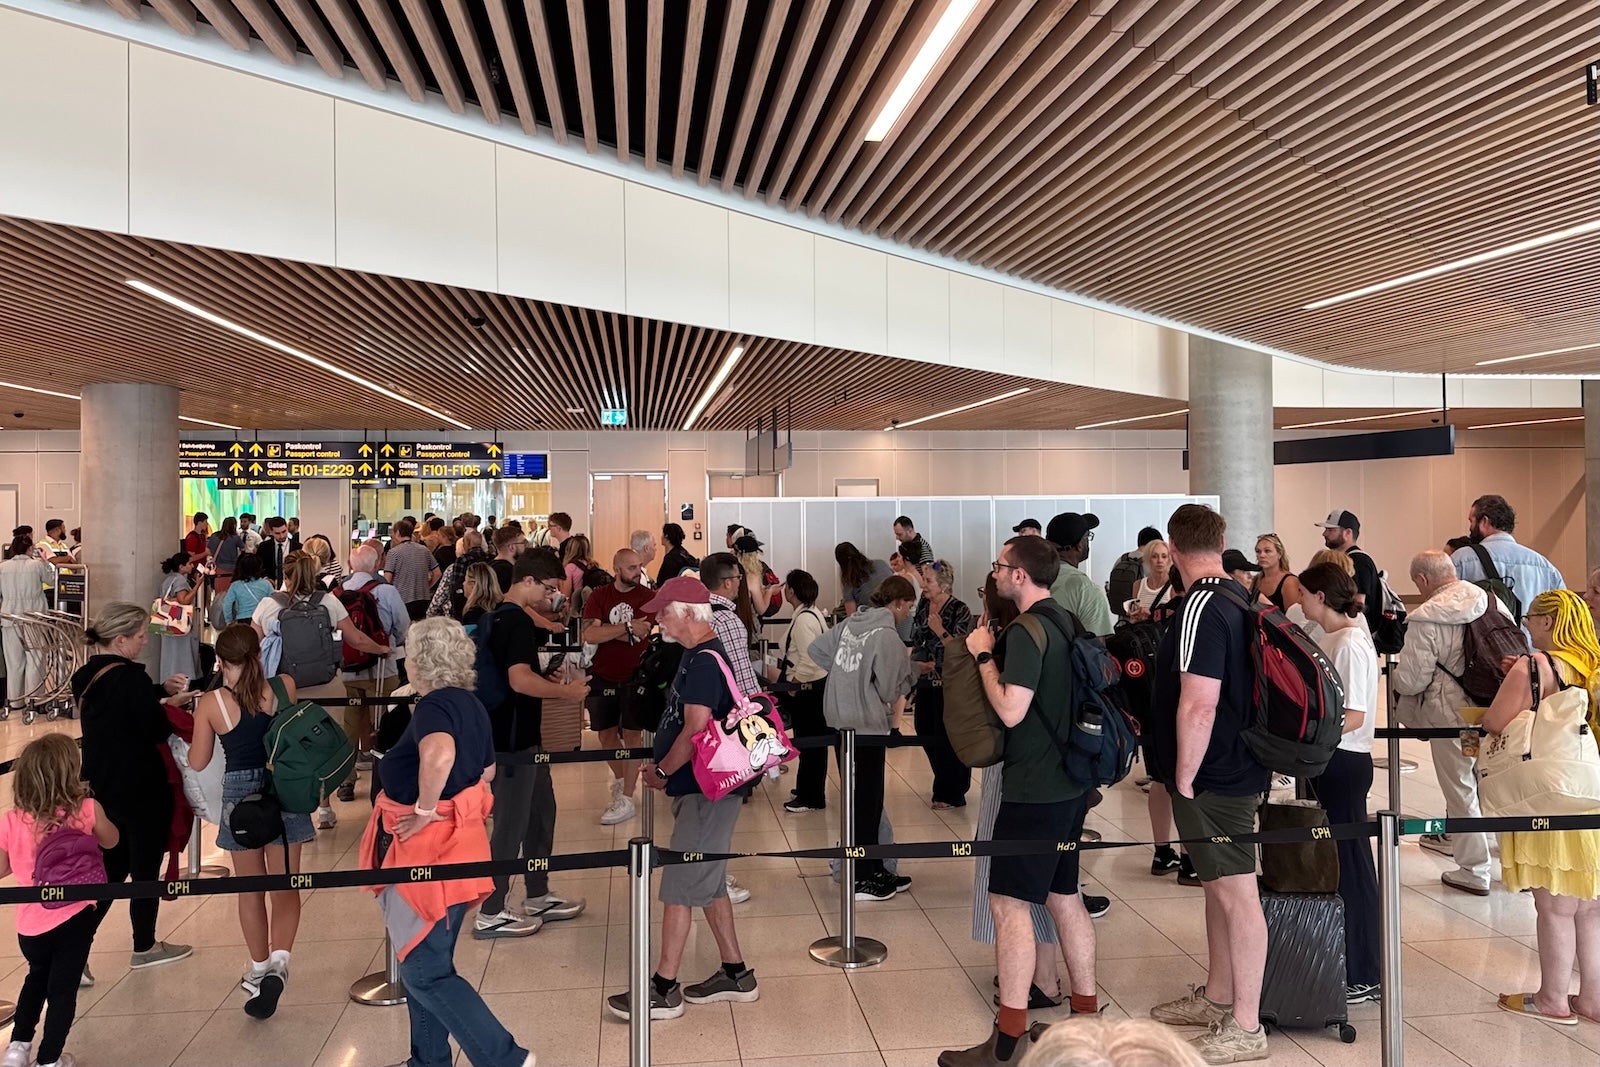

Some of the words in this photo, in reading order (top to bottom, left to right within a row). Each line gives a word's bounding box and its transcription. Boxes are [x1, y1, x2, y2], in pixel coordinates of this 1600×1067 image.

[292, 464, 355, 476] E101-E229
[422, 464, 480, 476] F101-F105
[535, 754, 550, 764] CPH
[615, 750, 630, 760] CPH
[1532, 818, 1550, 830] CPH
[1312, 827, 1331, 840] CPH
[845, 847, 866, 858] CPH
[952, 843, 971, 856] CPH
[683, 852, 703, 862] CPH
[527, 858, 548, 872] CPH
[410, 867, 432, 880] CPH
[290, 874, 312, 888] CPH
[168, 881, 190, 894] CPH
[41, 888, 64, 900] CPH
